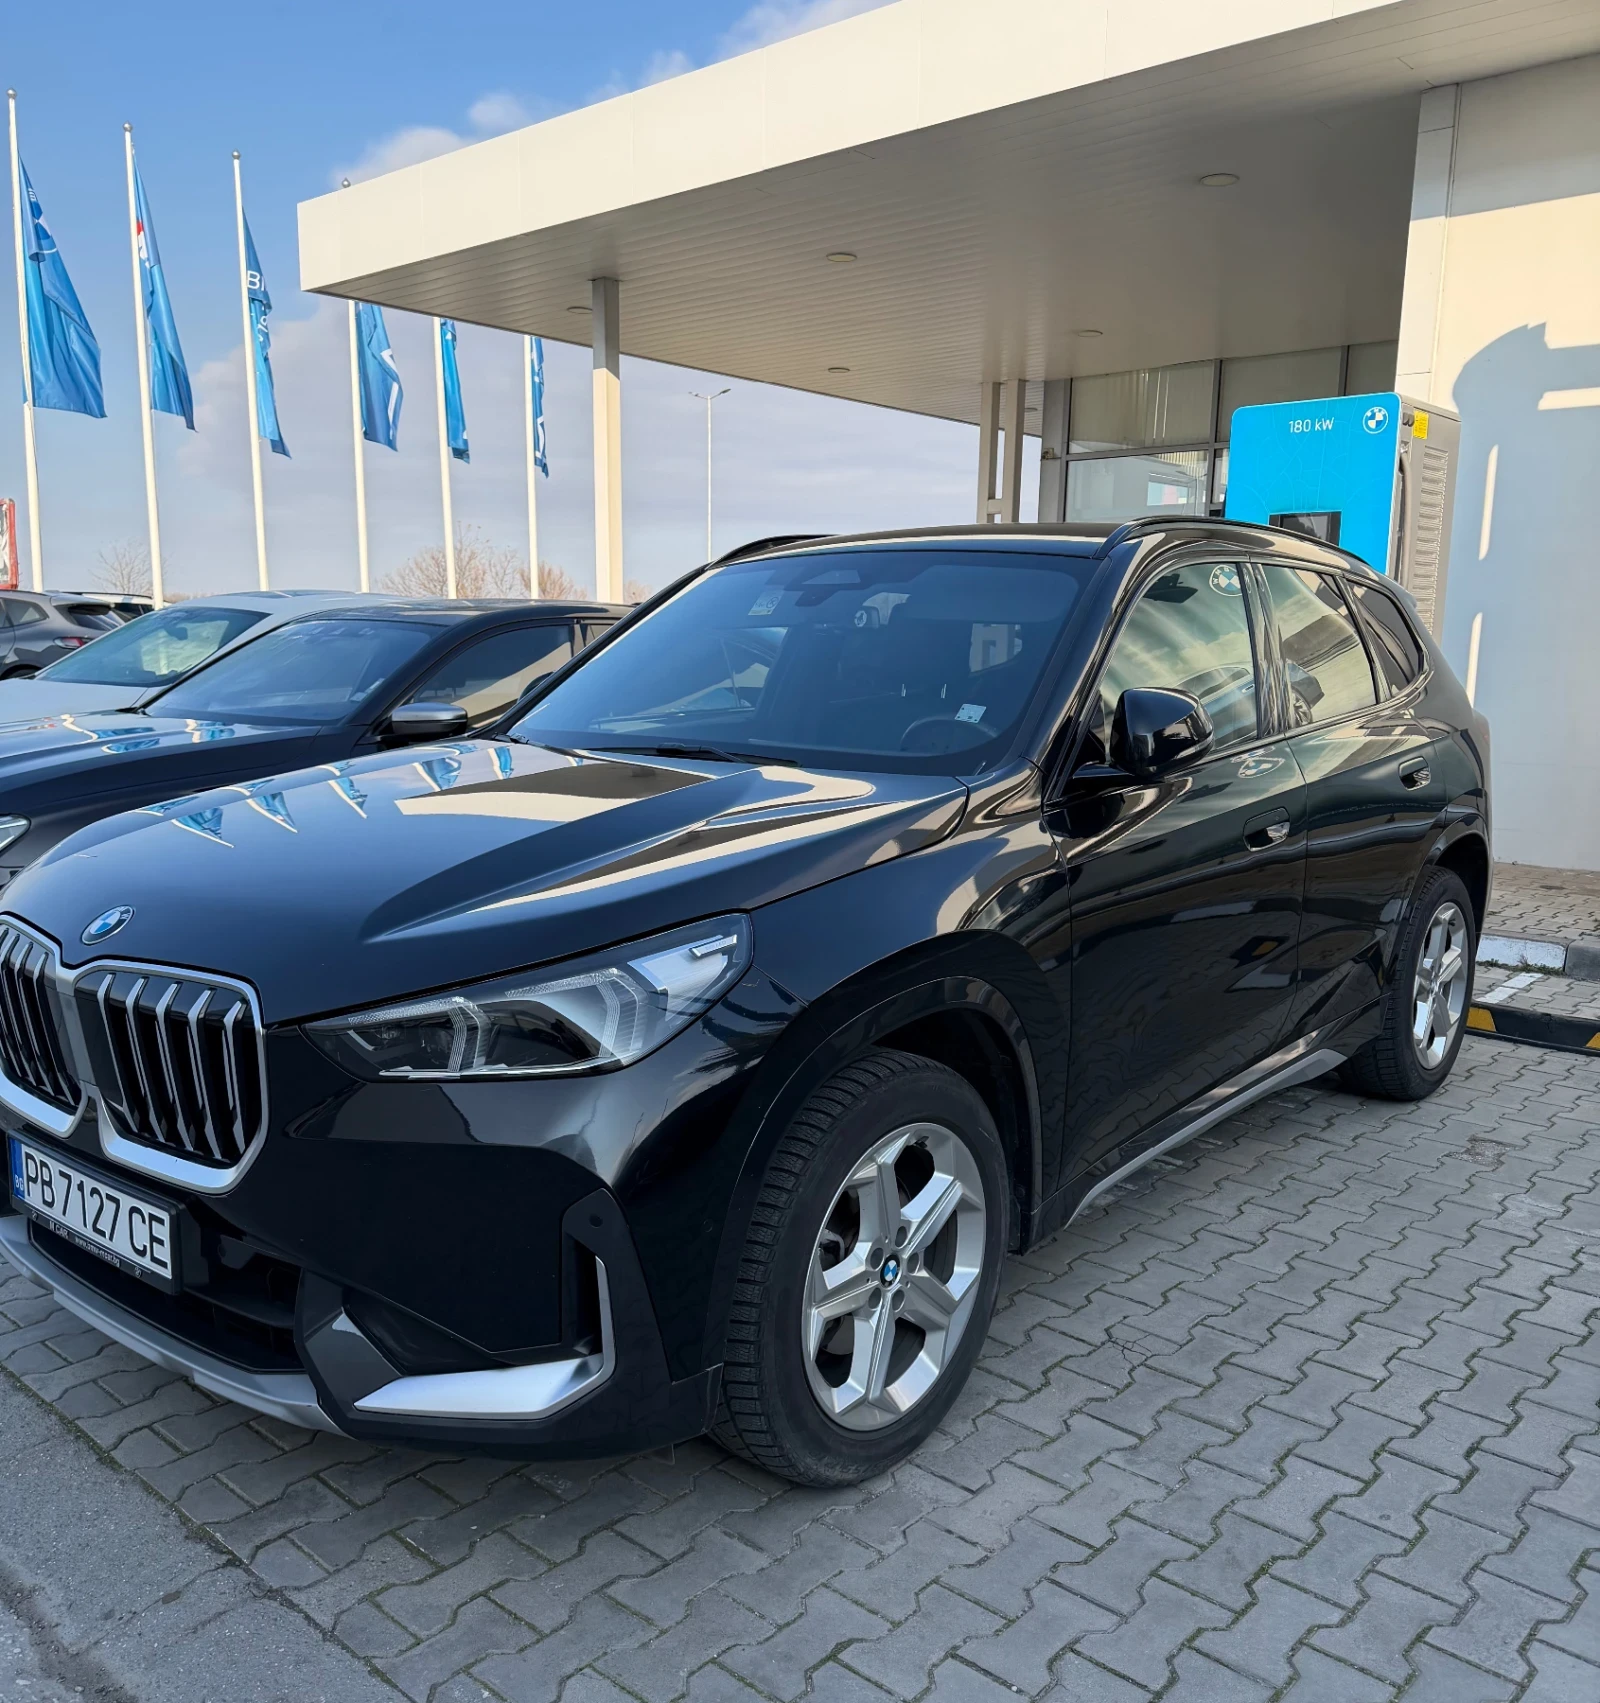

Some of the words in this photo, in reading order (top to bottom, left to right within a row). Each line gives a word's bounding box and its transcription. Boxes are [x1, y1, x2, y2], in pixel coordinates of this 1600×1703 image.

[1289, 420, 1311, 433] 180
[1315, 417, 1335, 431] kW
[15, 1174, 24, 1190] BG
[24, 1150, 56, 1209] PB
[58, 1169, 121, 1242] 7127
[128, 1205, 169, 1270] CE
[55, 1224, 69, 1240] CAR
